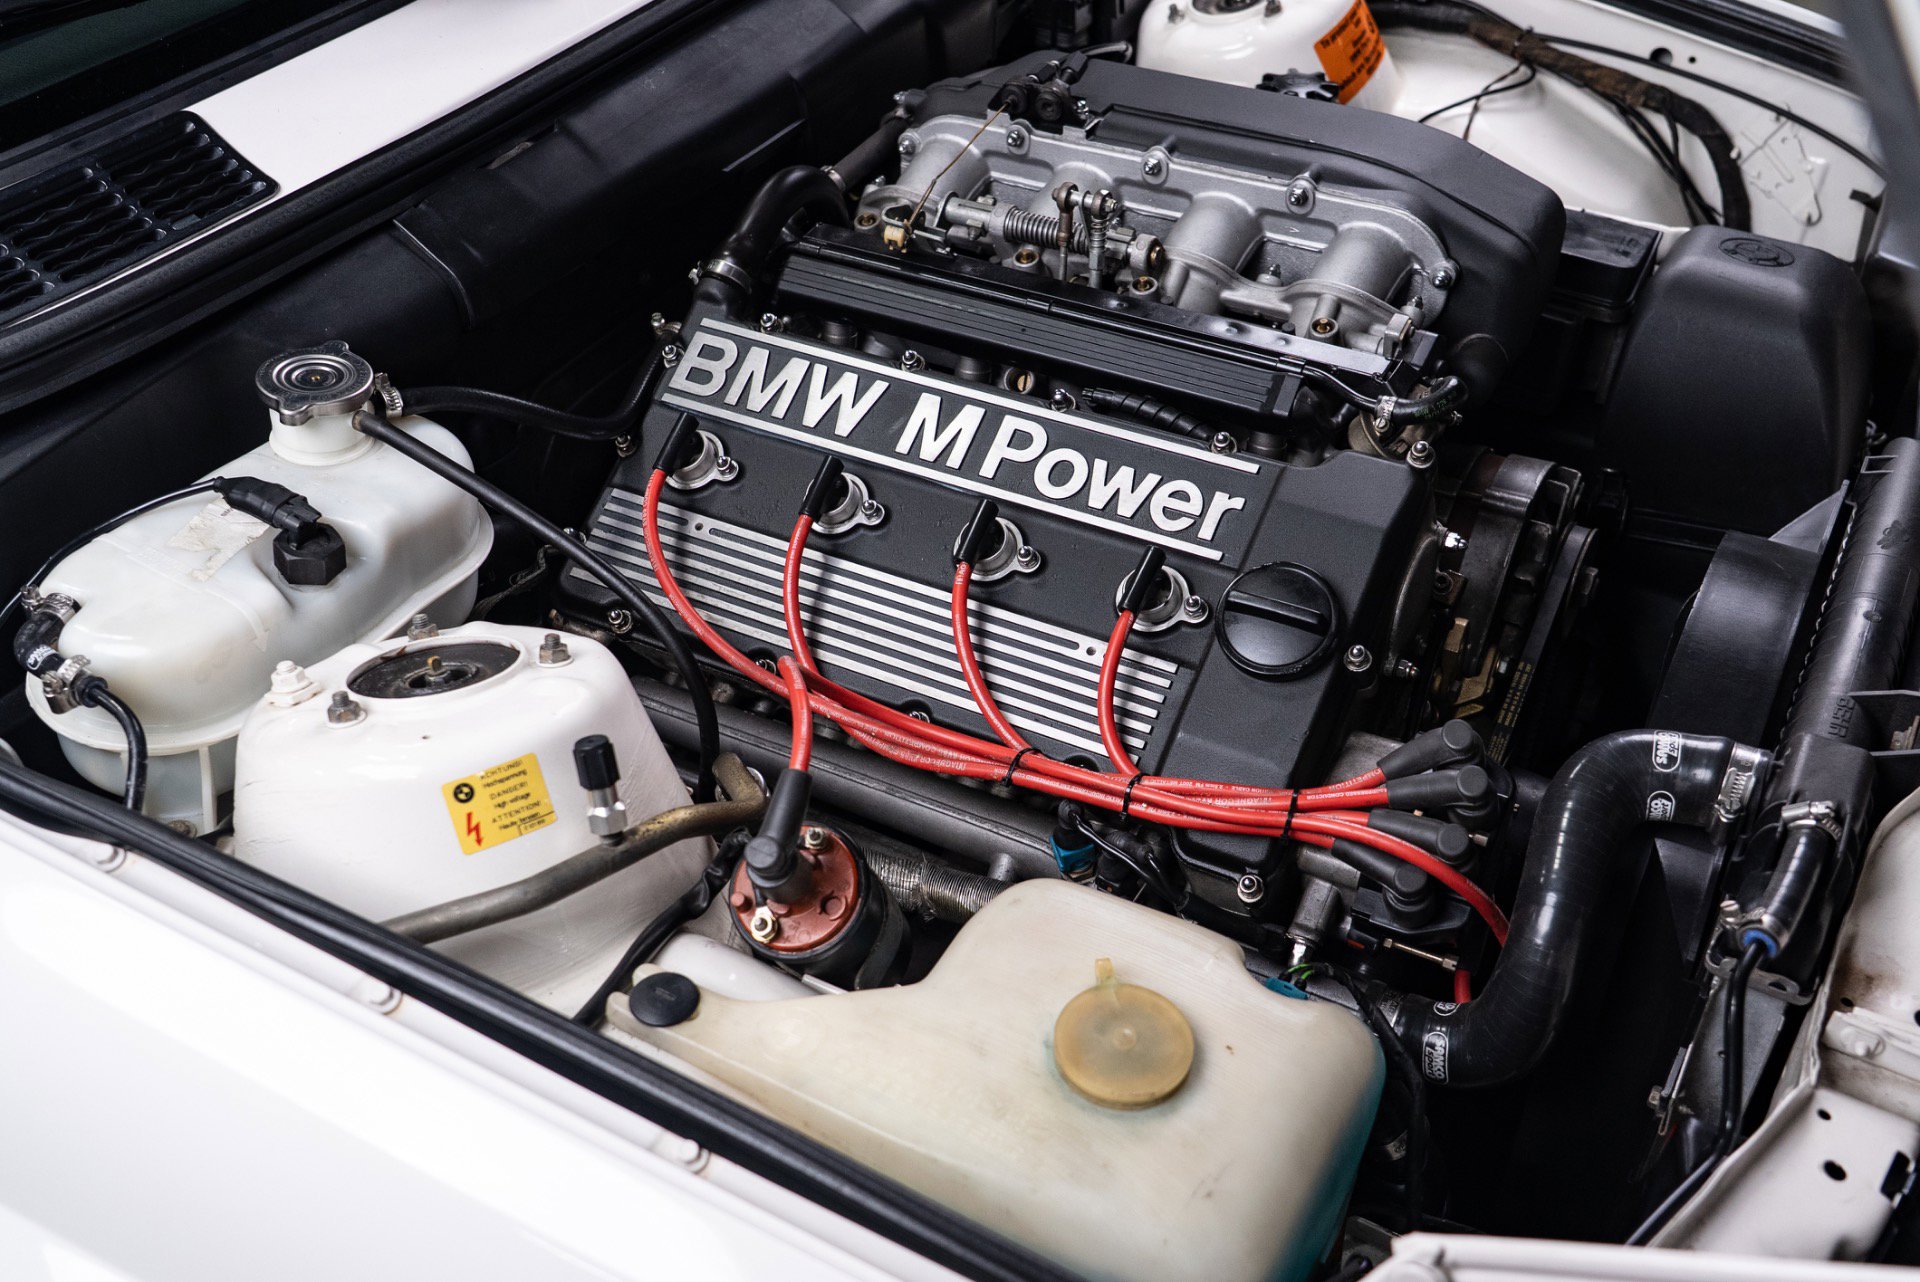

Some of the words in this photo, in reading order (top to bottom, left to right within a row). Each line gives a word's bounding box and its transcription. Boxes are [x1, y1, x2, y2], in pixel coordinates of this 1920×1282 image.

[667, 332, 889, 437] BMW
[1305, 790, 1344, 801] CONDUCTOR
[1435, 1036, 1445, 1079] SAMCO
